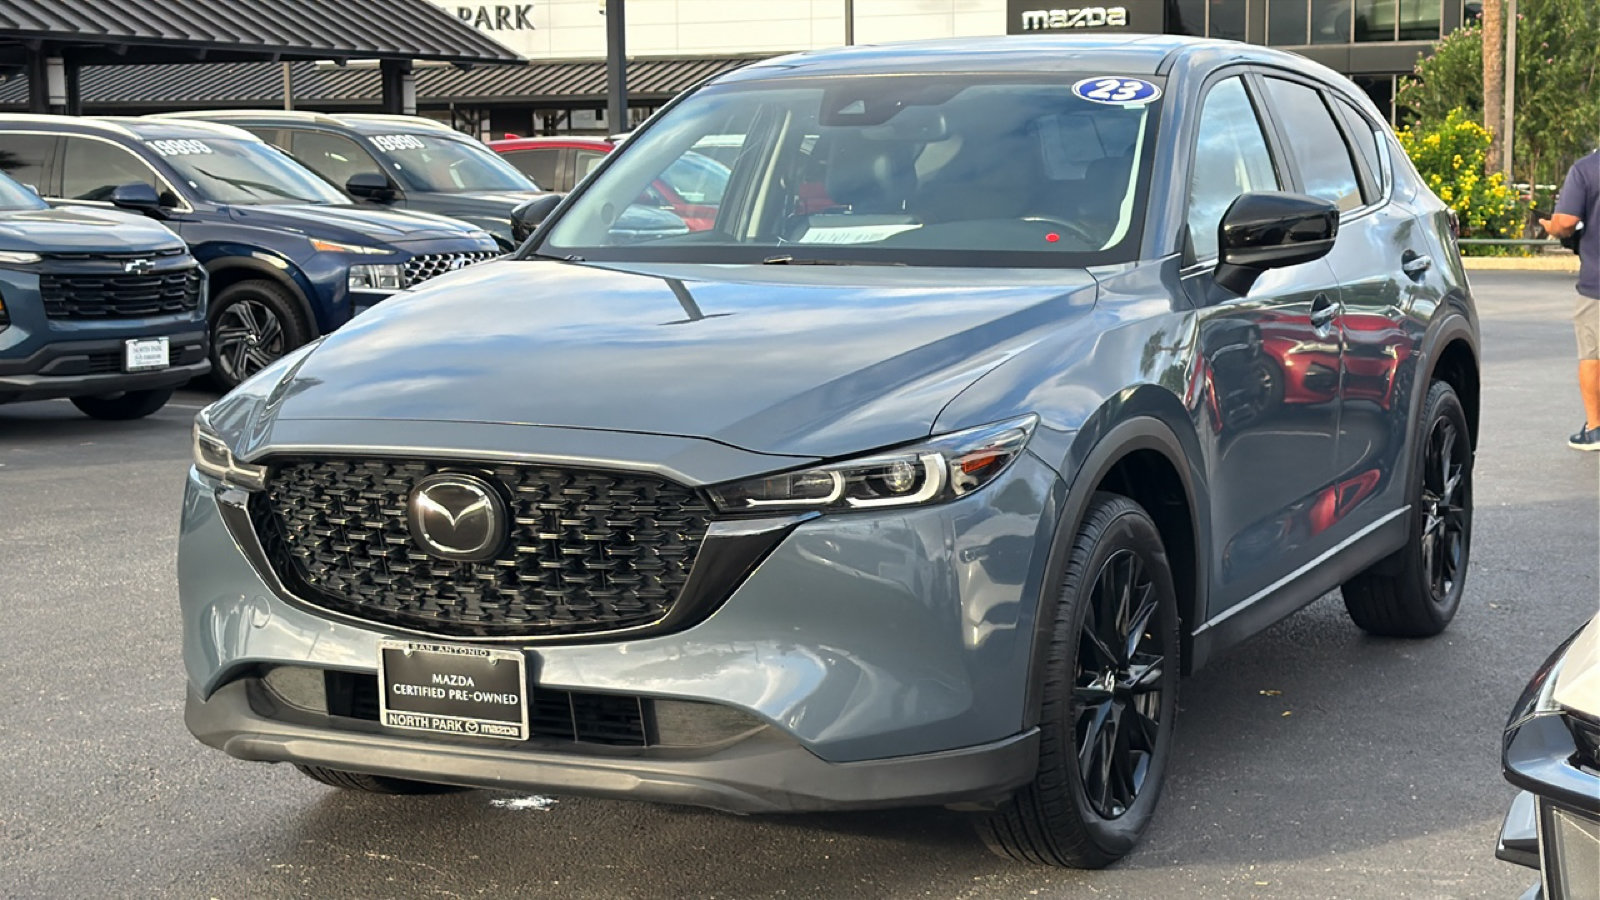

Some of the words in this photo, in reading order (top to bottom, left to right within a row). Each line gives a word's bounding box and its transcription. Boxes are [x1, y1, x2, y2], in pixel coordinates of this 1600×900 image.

[457, 4, 535, 31] PARK
[1087, 79, 1144, 101] 23
[411, 643, 433, 652] SAN
[439, 645, 488, 656] ANTONIO
[432, 673, 475, 687] MAZDA
[393, 683, 446, 699] CERTIFIED
[448, 689, 519, 705] PRE-OWNED
[389, 713, 429, 728] NORTH
[432, 718, 464, 732] PARK
